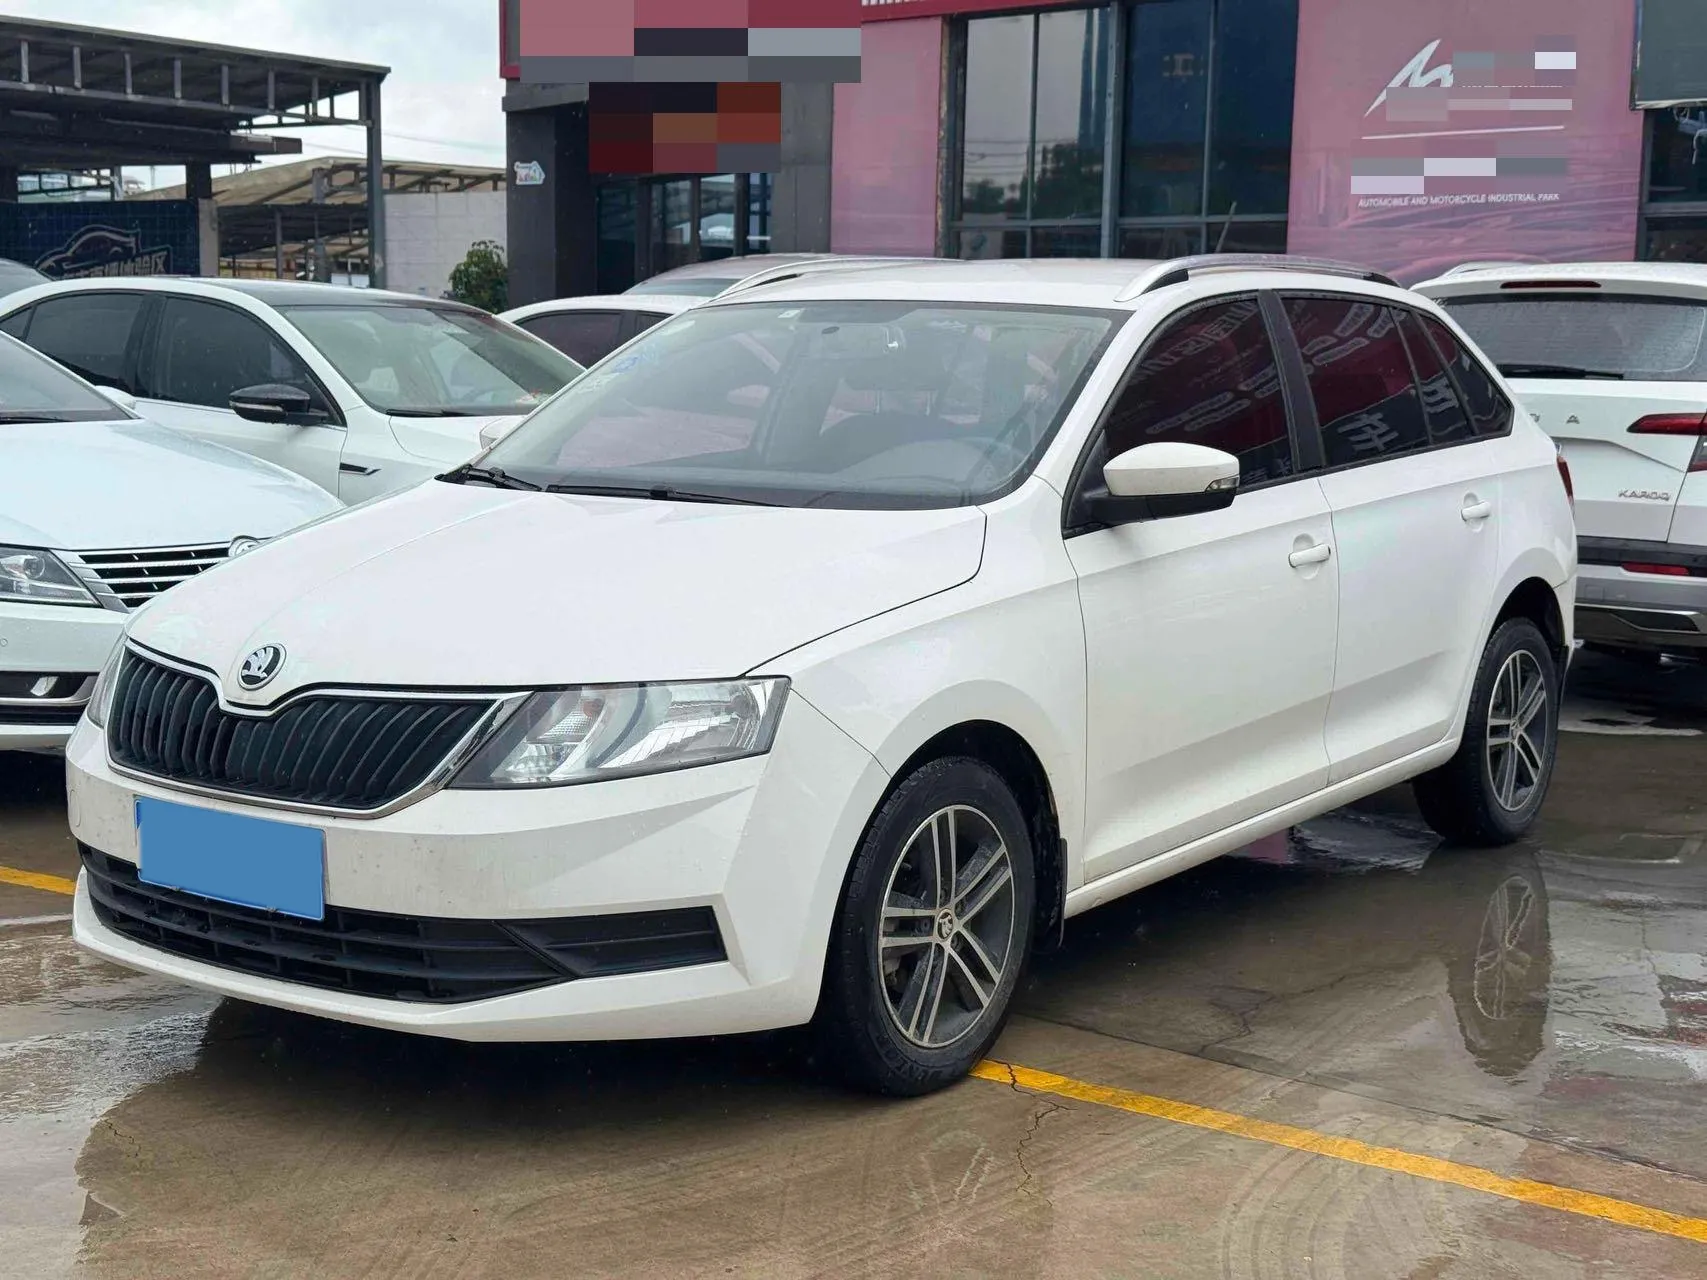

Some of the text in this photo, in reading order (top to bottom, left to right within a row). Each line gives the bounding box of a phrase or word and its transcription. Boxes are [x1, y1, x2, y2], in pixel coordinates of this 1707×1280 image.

[1358, 193, 1560, 208] AUTOMOBILE AND MOTORCYCLE INDUSTRIAL PARK
[1618, 489, 1670, 501] KAROQ
